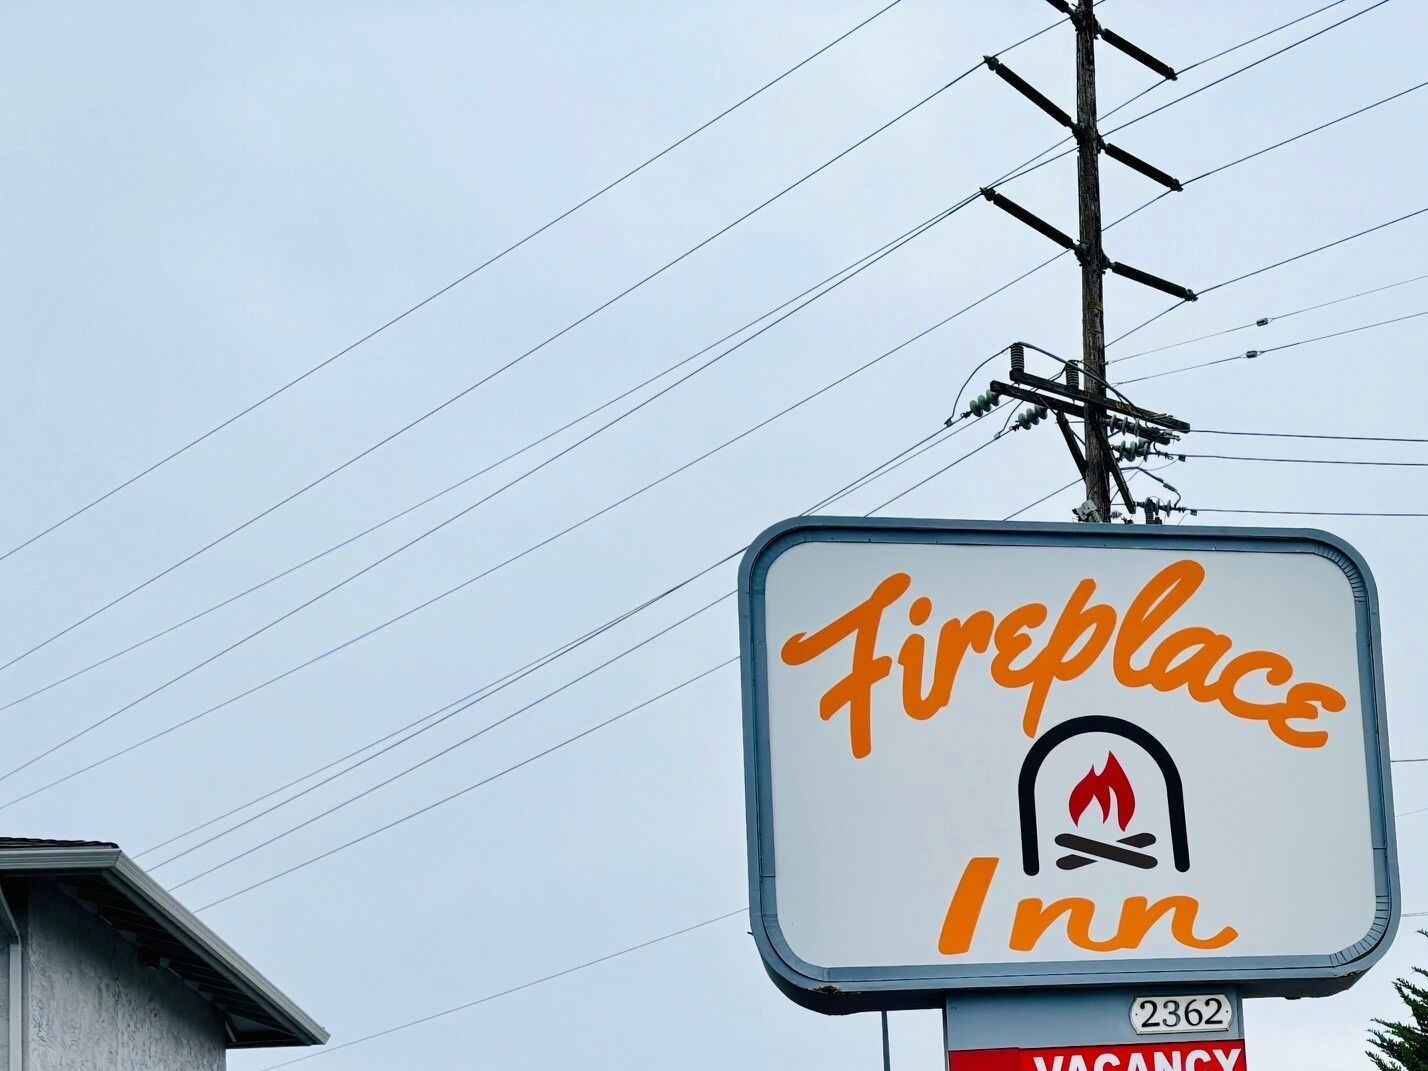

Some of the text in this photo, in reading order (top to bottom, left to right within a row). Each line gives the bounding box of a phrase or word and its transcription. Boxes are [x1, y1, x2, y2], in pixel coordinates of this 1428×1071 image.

[780, 559, 1346, 760] Fireplace
[938, 857, 1239, 955] Inn
[1139, 997, 1225, 1028] 2362
